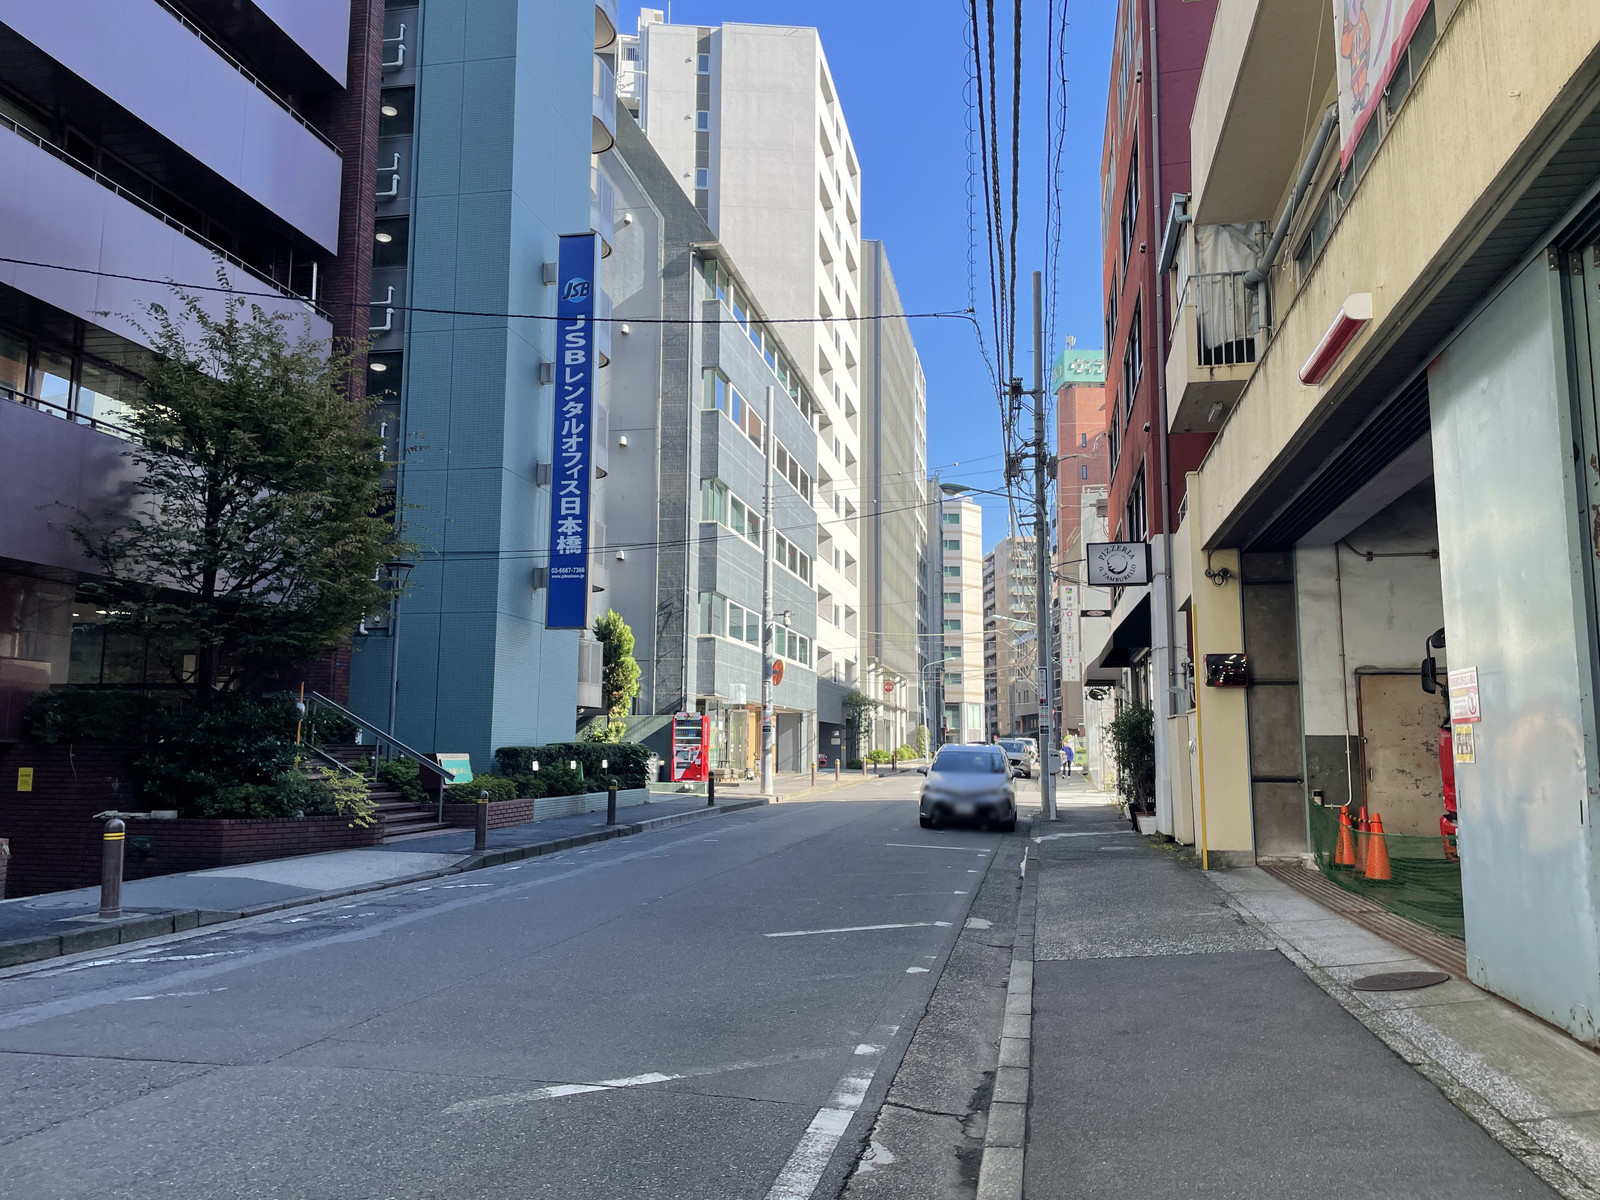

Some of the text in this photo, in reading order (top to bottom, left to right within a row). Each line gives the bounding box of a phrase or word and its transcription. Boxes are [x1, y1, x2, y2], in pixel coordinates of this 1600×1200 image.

[561, 281, 590, 300] JSB
[556, 314, 586, 555] JSBレンタルオフィス日本橋
[1098, 545, 1135, 560] PIZZERIA
[1102, 564, 1136, 582] TAMBURELLO
